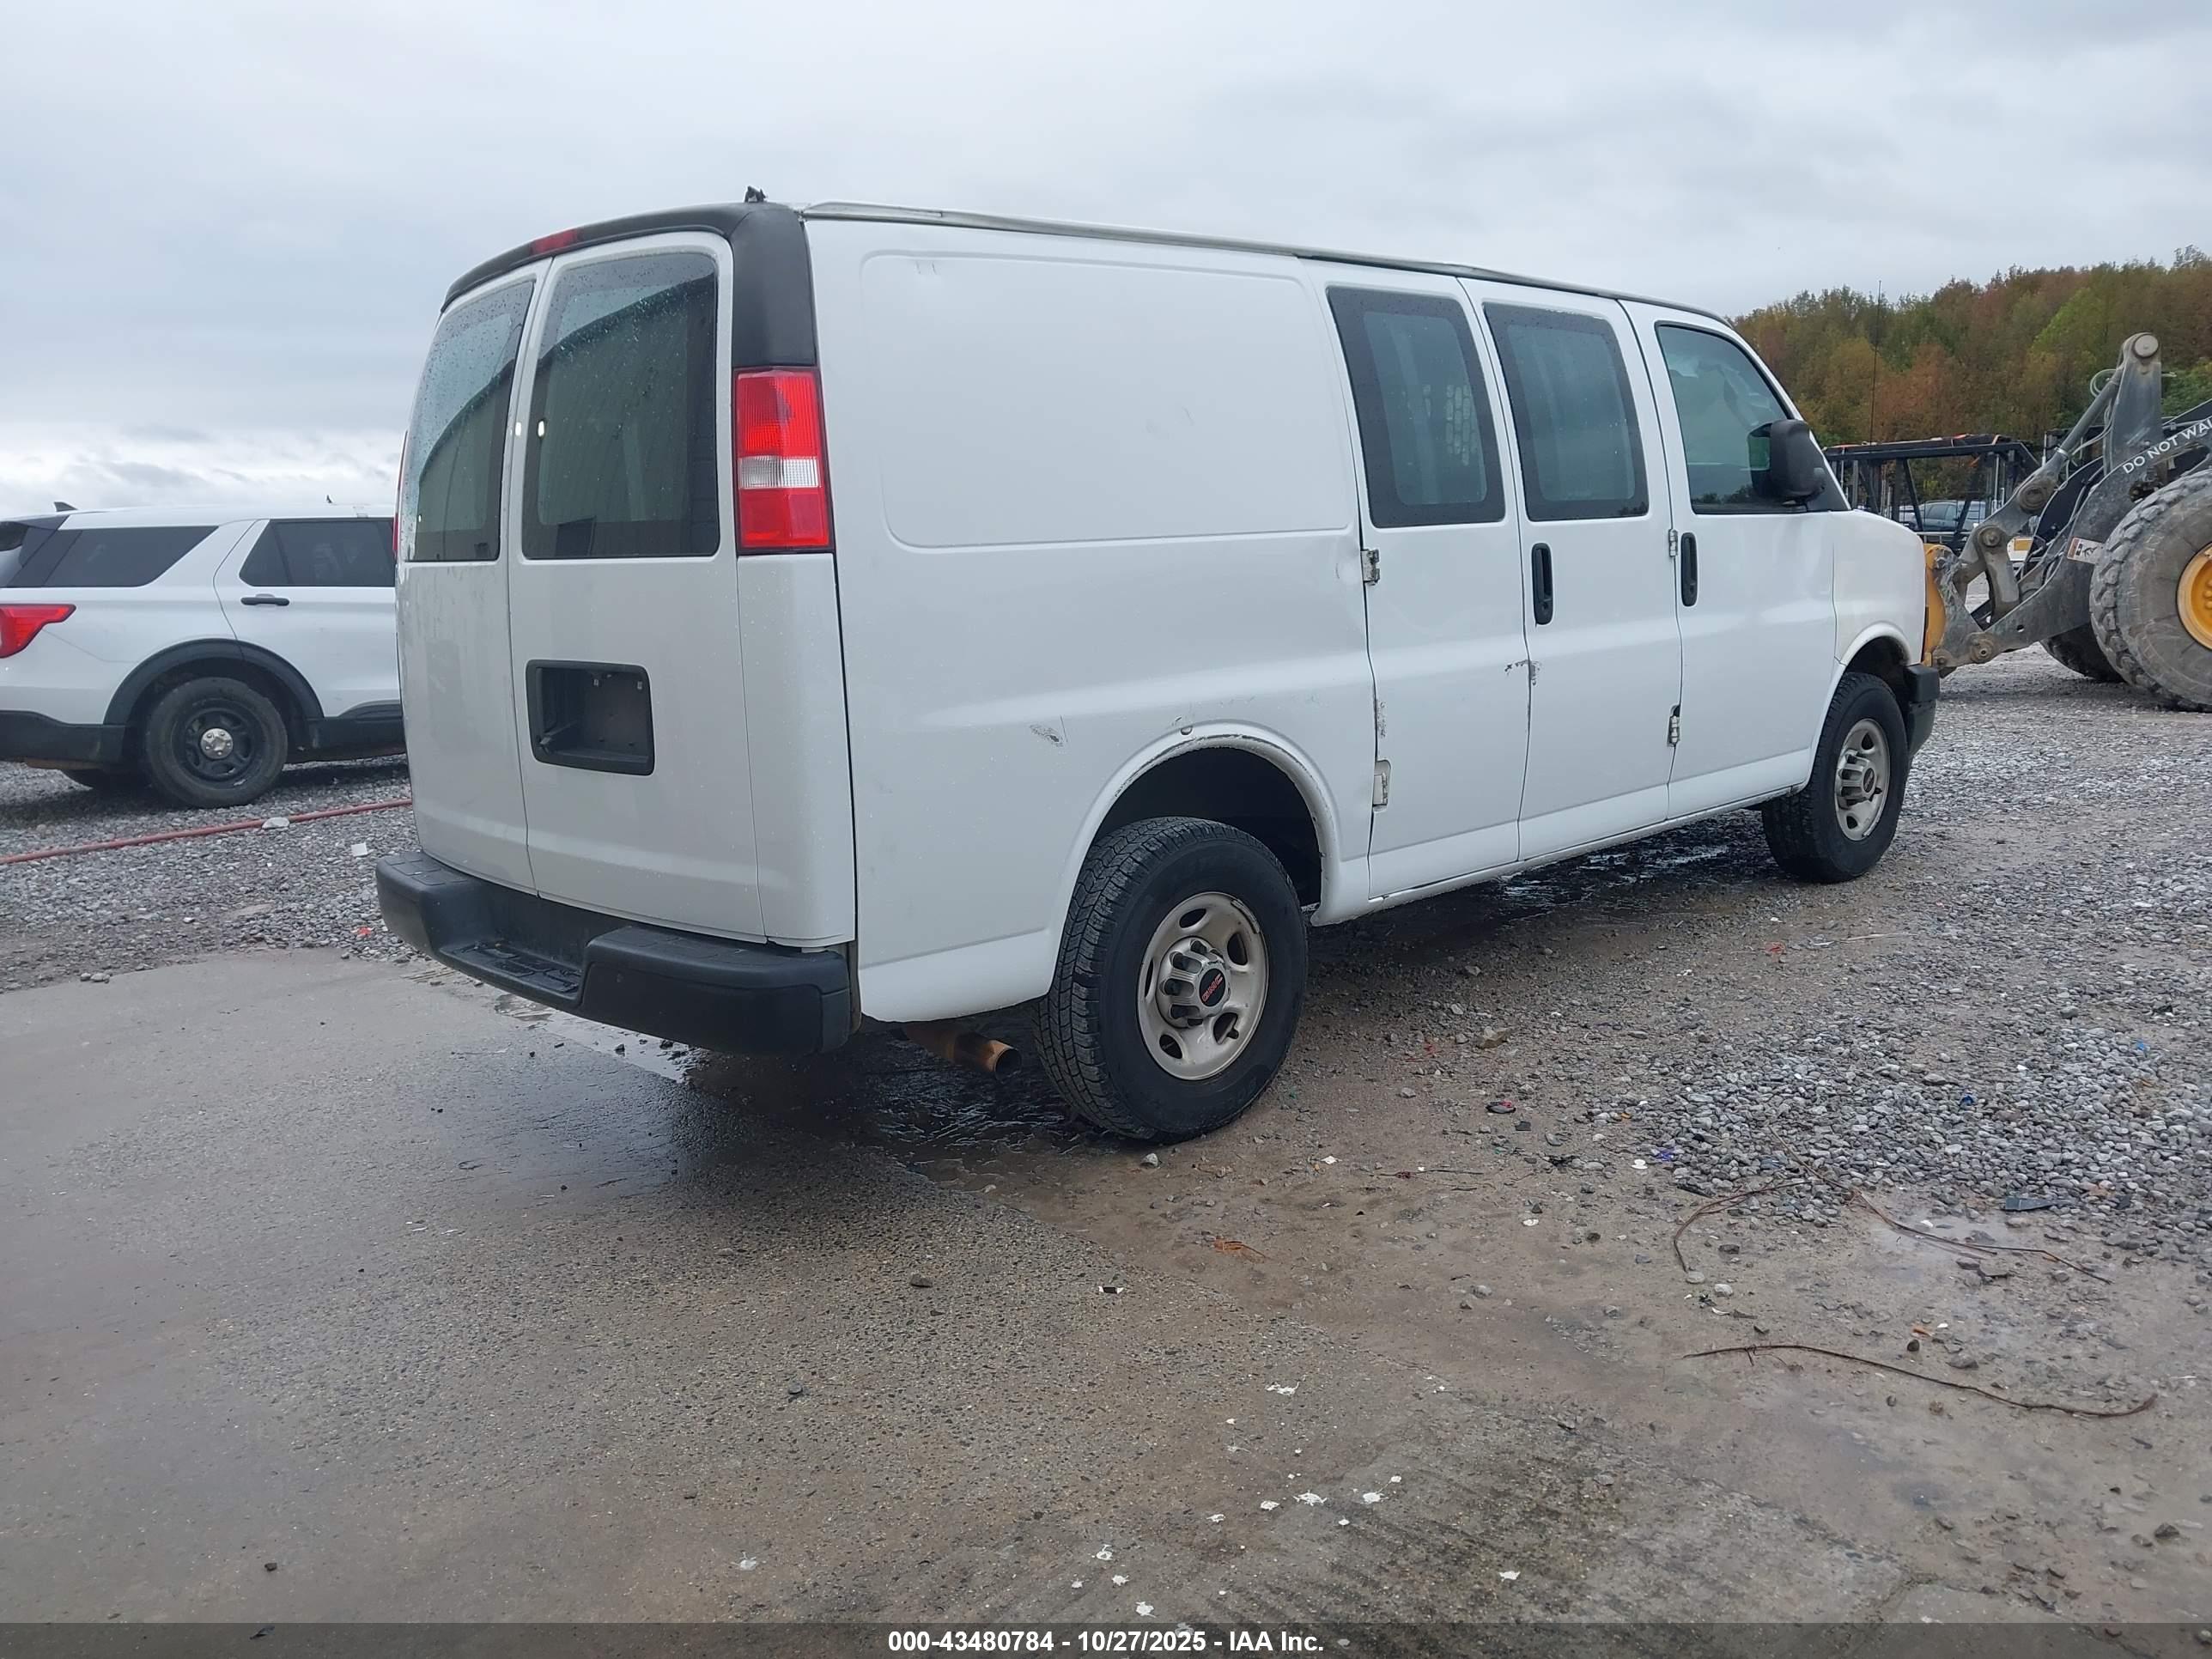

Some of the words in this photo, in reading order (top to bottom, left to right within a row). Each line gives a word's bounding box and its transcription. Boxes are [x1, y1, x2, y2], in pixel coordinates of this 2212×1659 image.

[2123, 456, 2145, 474] DO
[2148, 434, 2178, 459] NOT
[1202, 973, 1223, 1002] GMC
